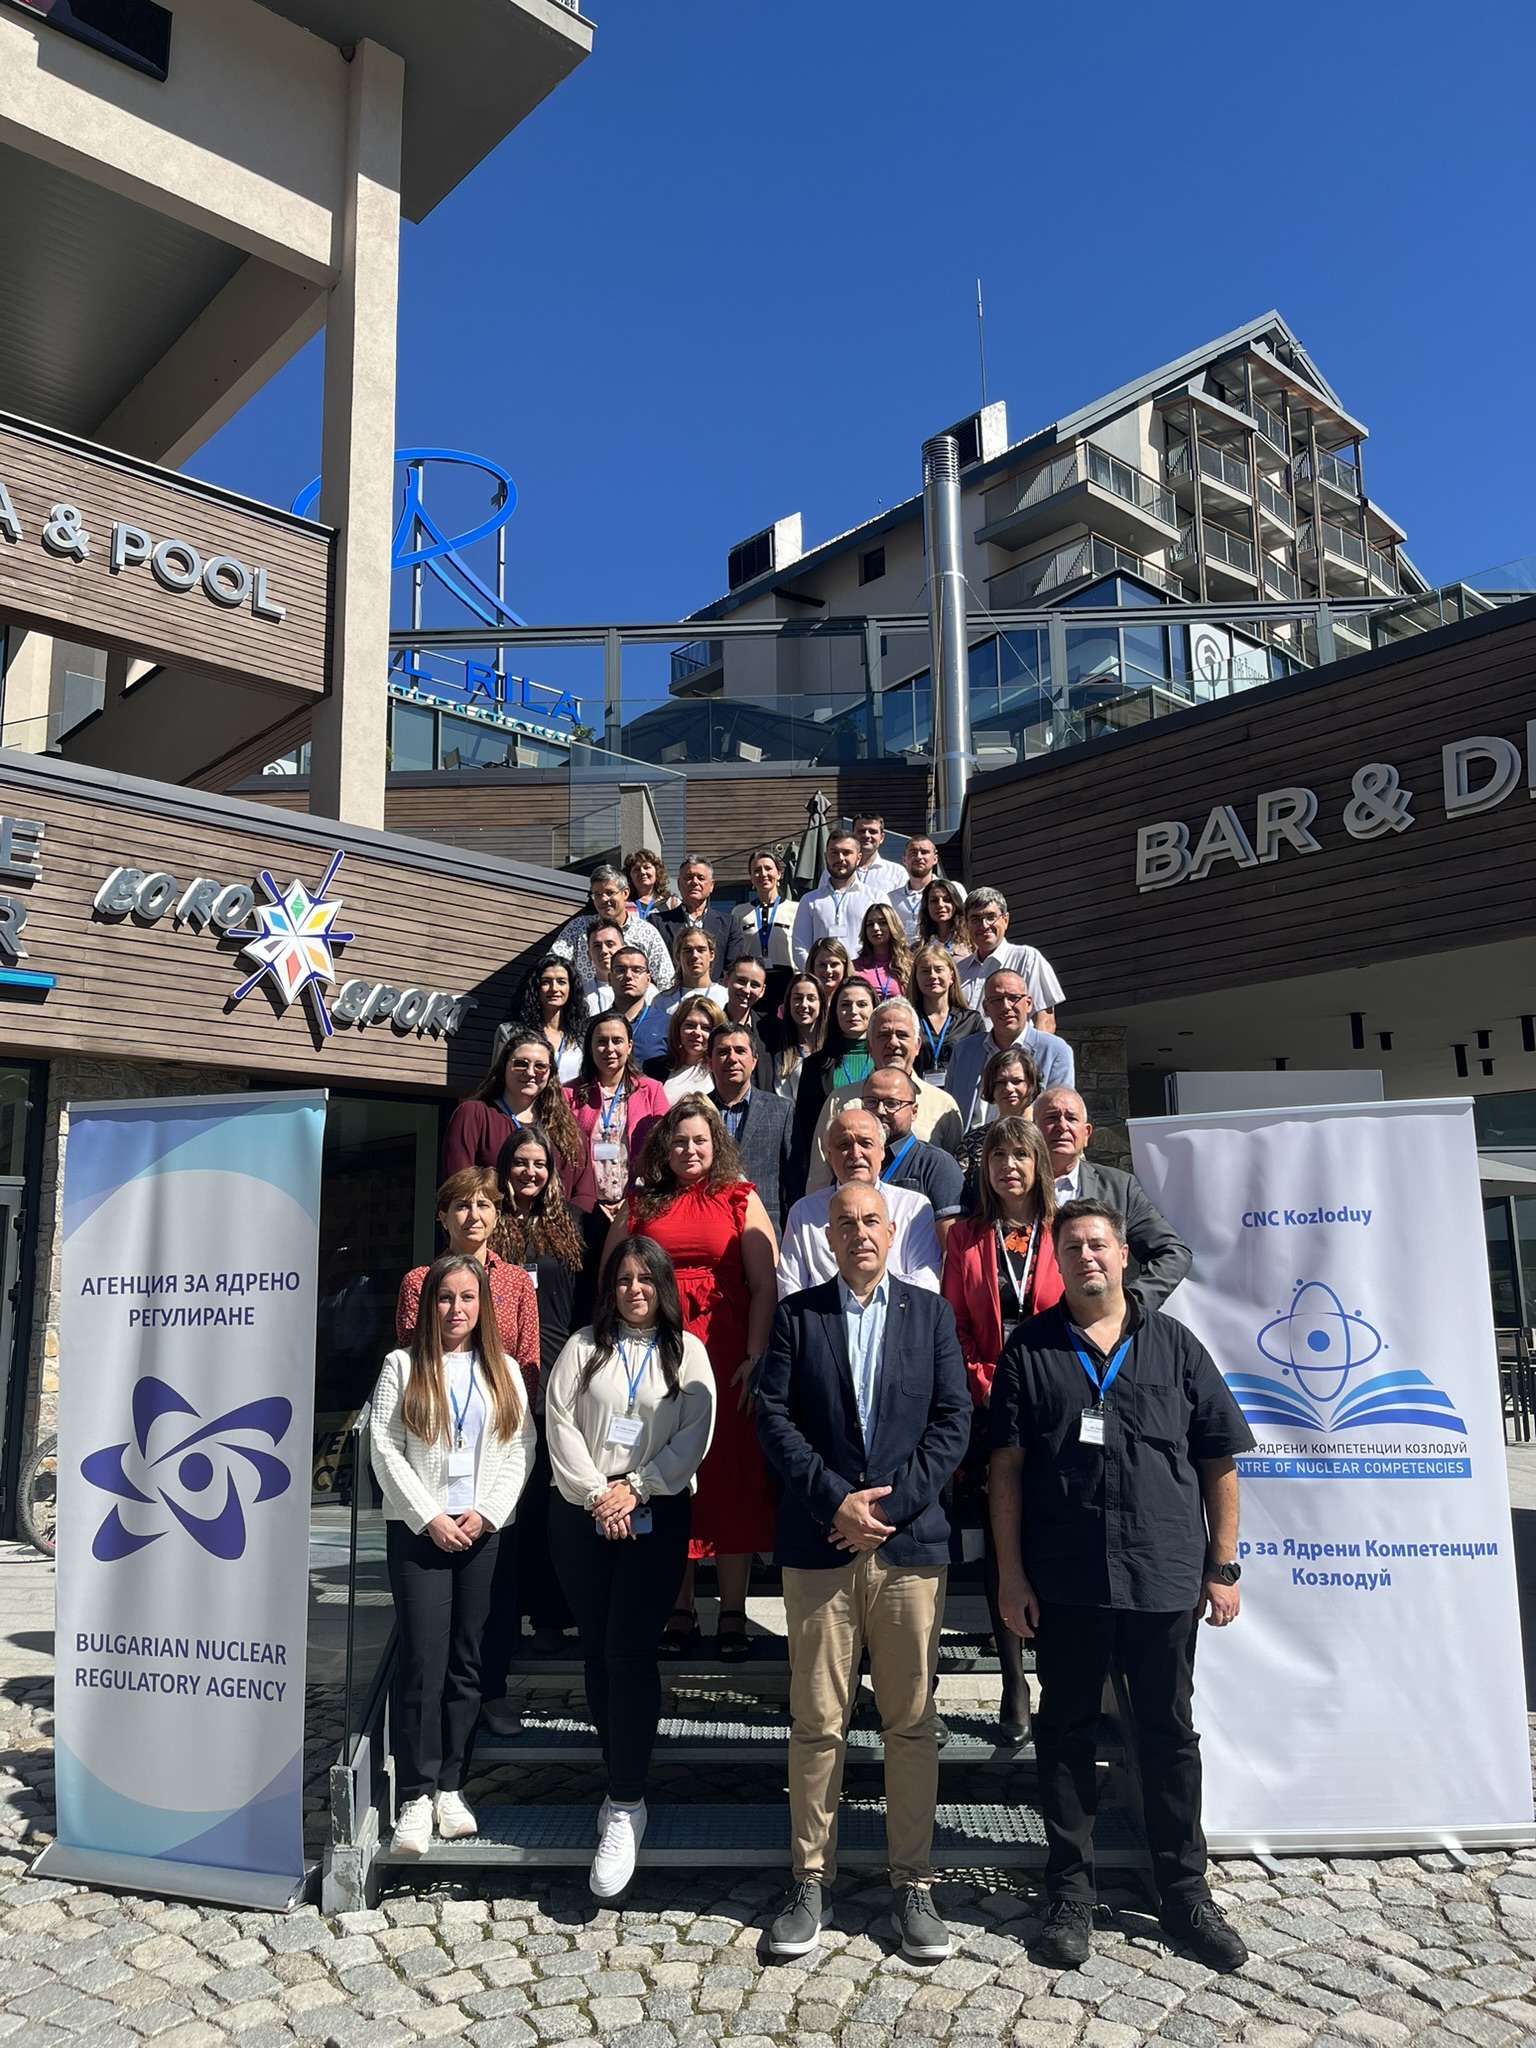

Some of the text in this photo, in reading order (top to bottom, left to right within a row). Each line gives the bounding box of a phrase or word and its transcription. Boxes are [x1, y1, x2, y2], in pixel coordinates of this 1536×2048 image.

[43, 504, 90, 557] &
[112, 521, 286, 619] POOL
[466, 660, 582, 725] RILA
[1136, 719, 1536, 893] BAR & D
[331, 979, 479, 1036] SPORT
[1241, 1206, 1372, 1227] CNC Kozloduy
[81, 1272, 300, 1297] АГЕНЦИЯ ЗА ЯДРЕНО
[129, 1307, 255, 1327] РЕГУЛИРАНЕ
[1259, 1444, 1307, 1455] ЯДРЕНИ
[1312, 1443, 1401, 1455] КОМПЕТЕНЦИИ
[1405, 1441, 1467, 1455] КОЗЛОДУЙ
[1236, 1462, 1464, 1473] NTRE OF NUCLEAR COMPETENCIES
[1256, 1542, 1278, 1555] за
[1283, 1539, 1360, 1560] Ядрени
[1365, 1540, 1498, 1559] Компетенции
[1292, 1568, 1391, 1591] Козлодуй
[76, 1633, 287, 1665] BULGARIAN NUCLEAR
[75, 1668, 286, 1702] REGULATORY AGENCY
